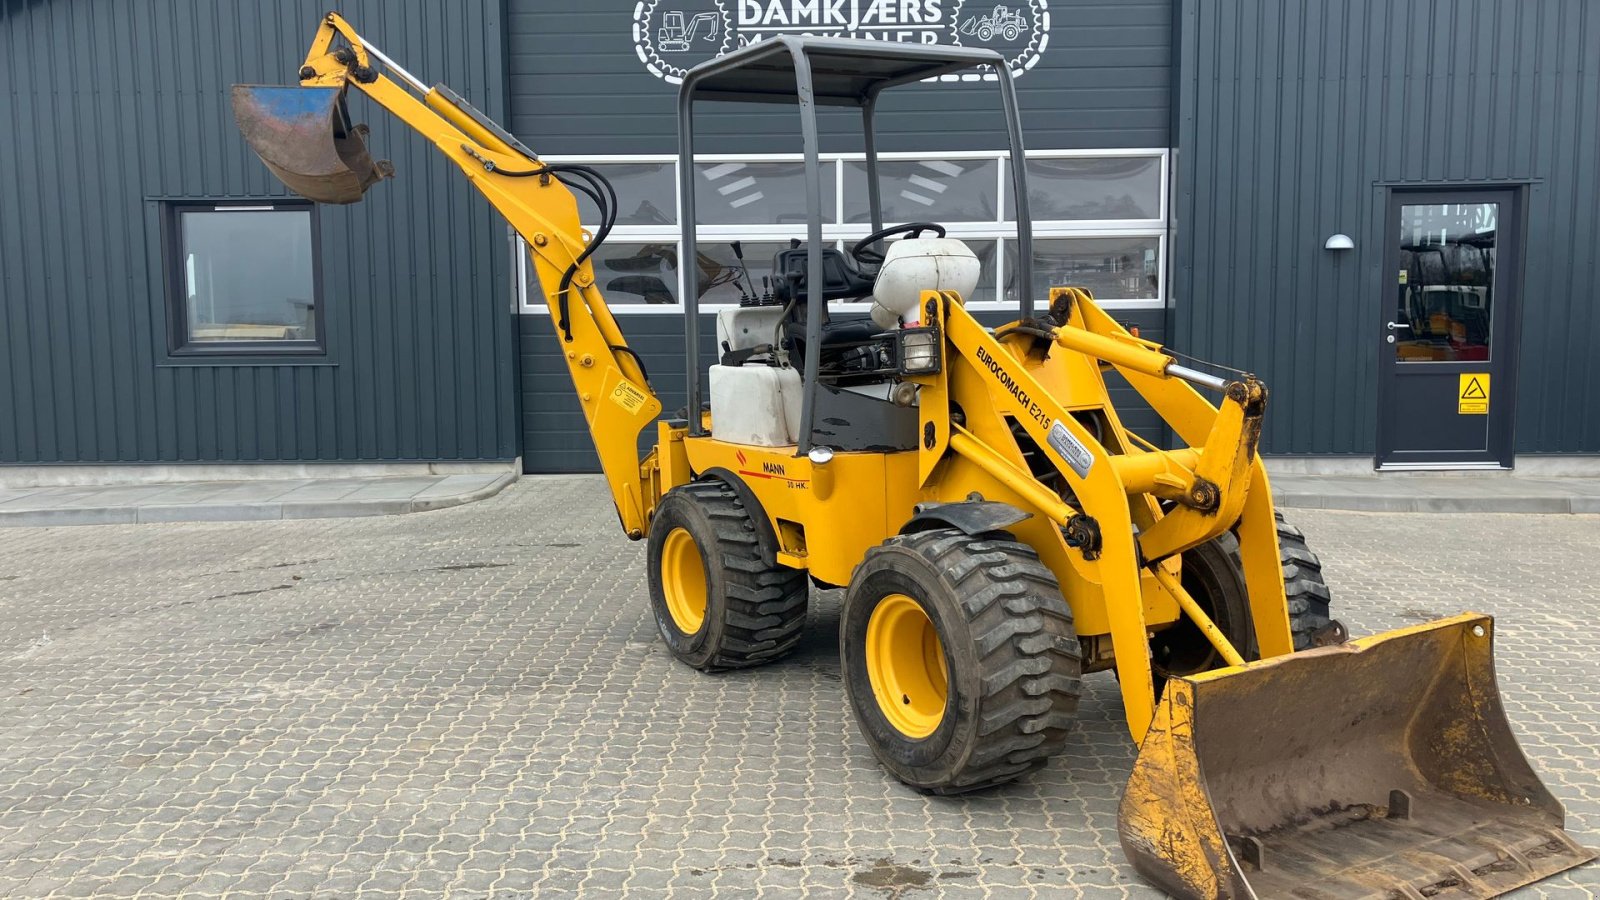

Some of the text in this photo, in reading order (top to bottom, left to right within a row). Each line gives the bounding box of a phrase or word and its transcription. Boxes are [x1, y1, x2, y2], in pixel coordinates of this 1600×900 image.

[737, 0, 942, 31] DAMKJÆRS
[976, 346, 1051, 430] EUROCOMACH E215
[763, 462, 785, 475] MANN
